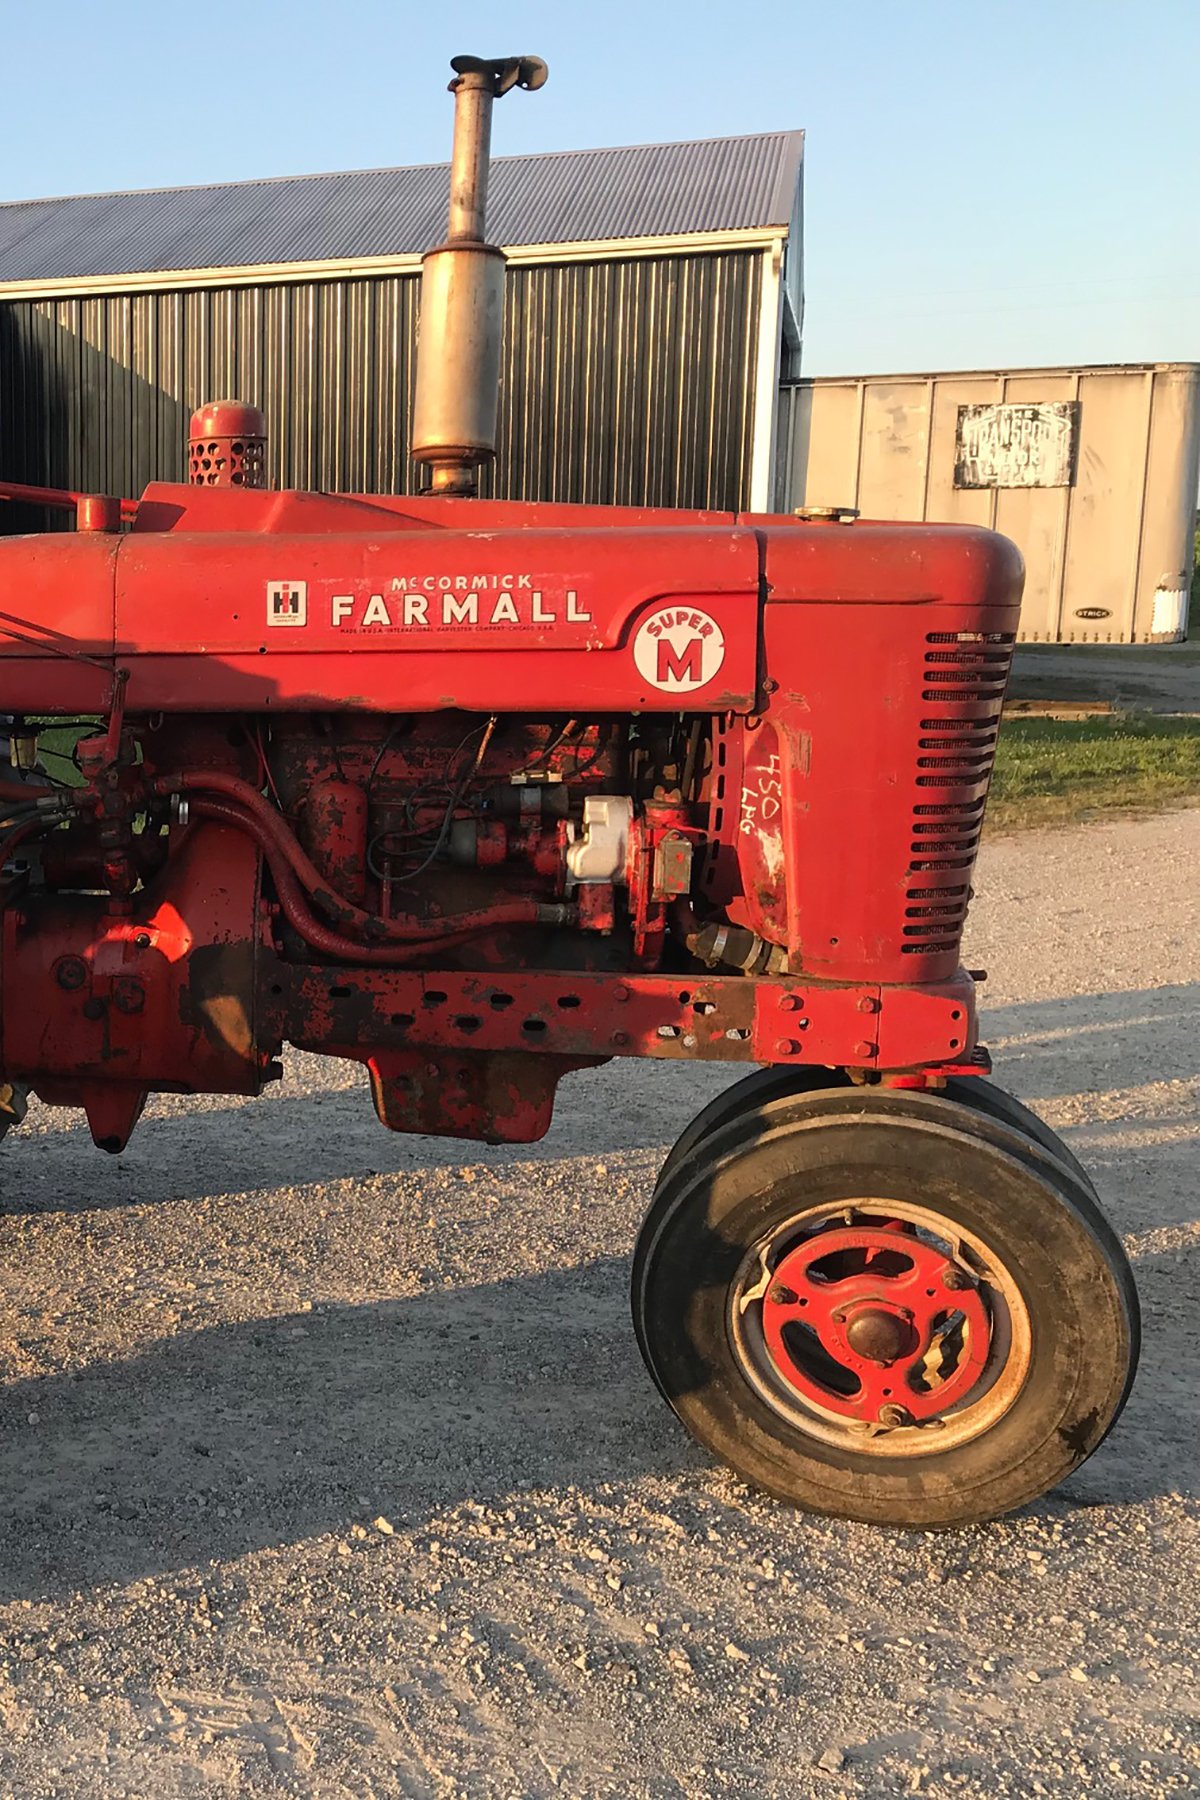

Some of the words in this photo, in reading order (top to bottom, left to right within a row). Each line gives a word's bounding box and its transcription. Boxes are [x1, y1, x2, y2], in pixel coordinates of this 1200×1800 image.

[331, 591, 592, 627] FARMALL
[646, 611, 714, 640] SUPER
[657, 638, 703, 682] M
